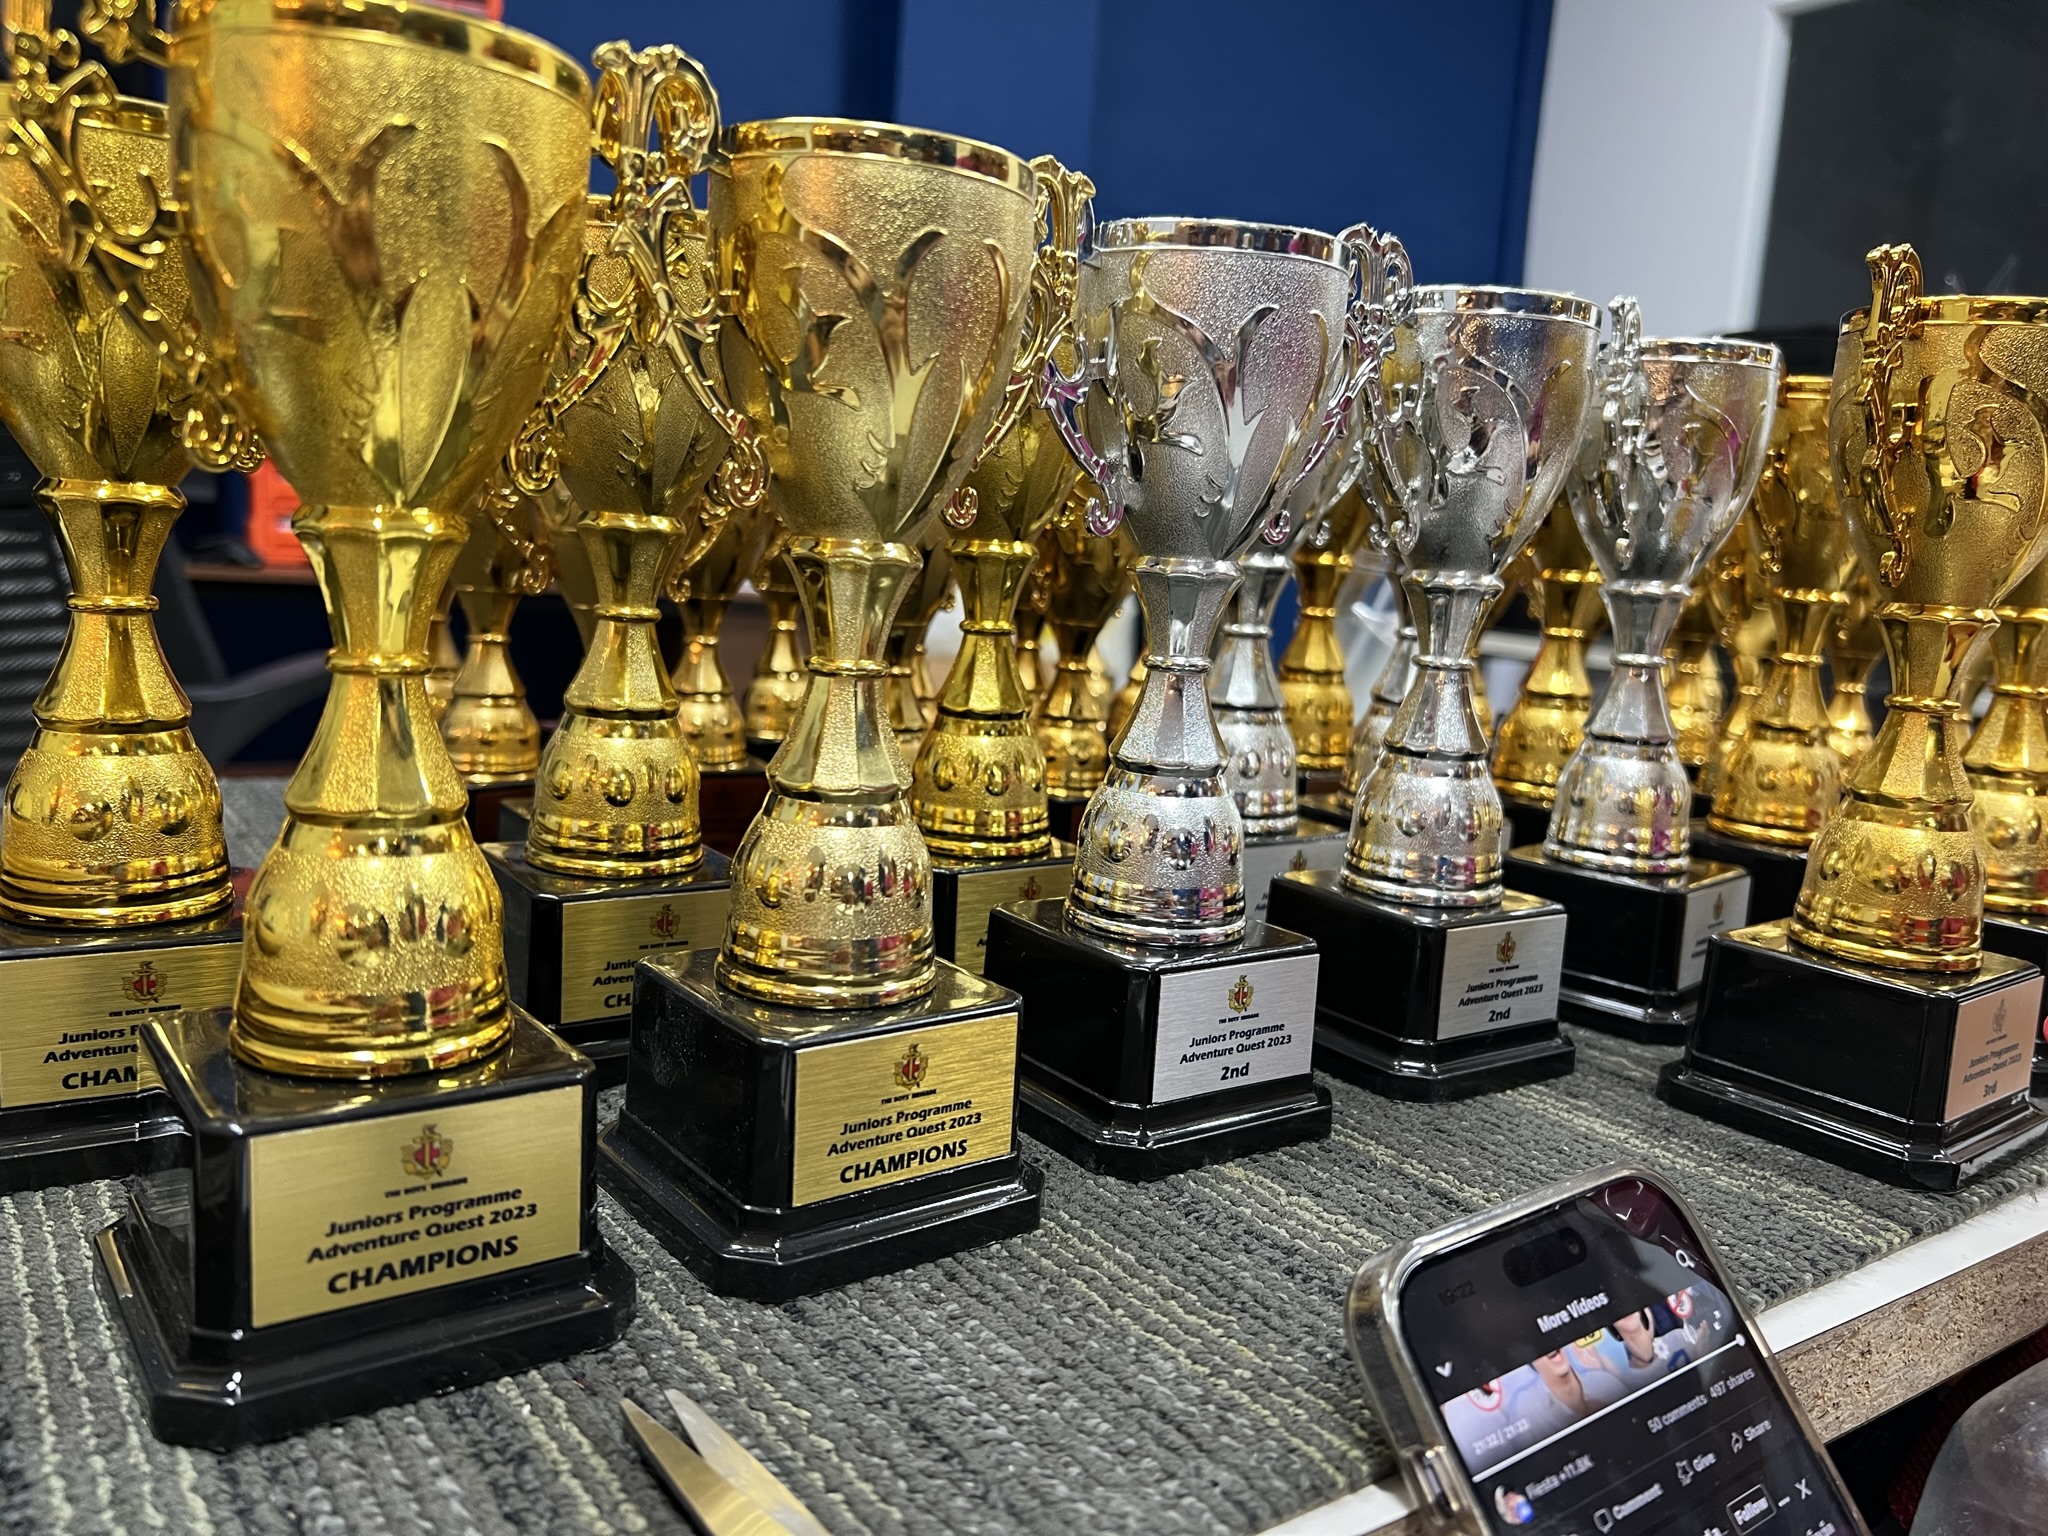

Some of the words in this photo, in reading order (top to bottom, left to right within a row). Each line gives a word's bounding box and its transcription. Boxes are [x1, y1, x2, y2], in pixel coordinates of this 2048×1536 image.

[604, 960, 637, 971] Junio
[593, 975, 634, 987] Adven
[1466, 981, 1494, 993] Juniors
[1496, 974, 1538, 988] Programme
[1458, 993, 1499, 1008] Adventure
[1500, 988, 1523, 999] Quest
[1524, 984, 1543, 995] 2023
[1488, 1006, 1511, 1022] 2nd
[58, 1027, 126, 1044] Juniors
[1189, 1033, 1226, 1047] Juniors
[1229, 1023, 1285, 1041] Programme
[43, 1043, 139, 1064] Adventure
[1180, 1045, 1233, 1064] Adventure
[1236, 1040, 1265, 1053] Quest
[1267, 1034, 1292, 1048] 2023
[1220, 1062, 1250, 1081] 2nd
[1983, 1080, 1998, 1098] 3rd
[840, 1115, 893, 1136] Juniors
[896, 1100, 972, 1124] Programme
[827, 1130, 903, 1156] Adventure
[906, 1119, 946, 1138] Quest
[948, 1112, 982, 1129] 2023
[840, 1139, 968, 1183] CHAMPIONS
[325, 1209, 403, 1237] Juniors
[409, 1187, 522, 1220] Programme
[307, 1228, 420, 1263] Adventure
[425, 1214, 484, 1238] Quest
[490, 1203, 538, 1225] 2023
[328, 1235, 519, 1294] CHAMPIONS
[1536, 1309, 1571, 1334] More
[1566, 1292, 1609, 1319] Videos
[1661, 1393, 1709, 1426] comments
[1709, 1381, 1726, 1399] 497
[1726, 1367, 1756, 1390] shares
[1743, 1419, 1772, 1442] Share
[1692, 1452, 1717, 1472] Give
[1612, 1482, 1664, 1520] Comment
[1733, 1496, 1769, 1526] Follow
